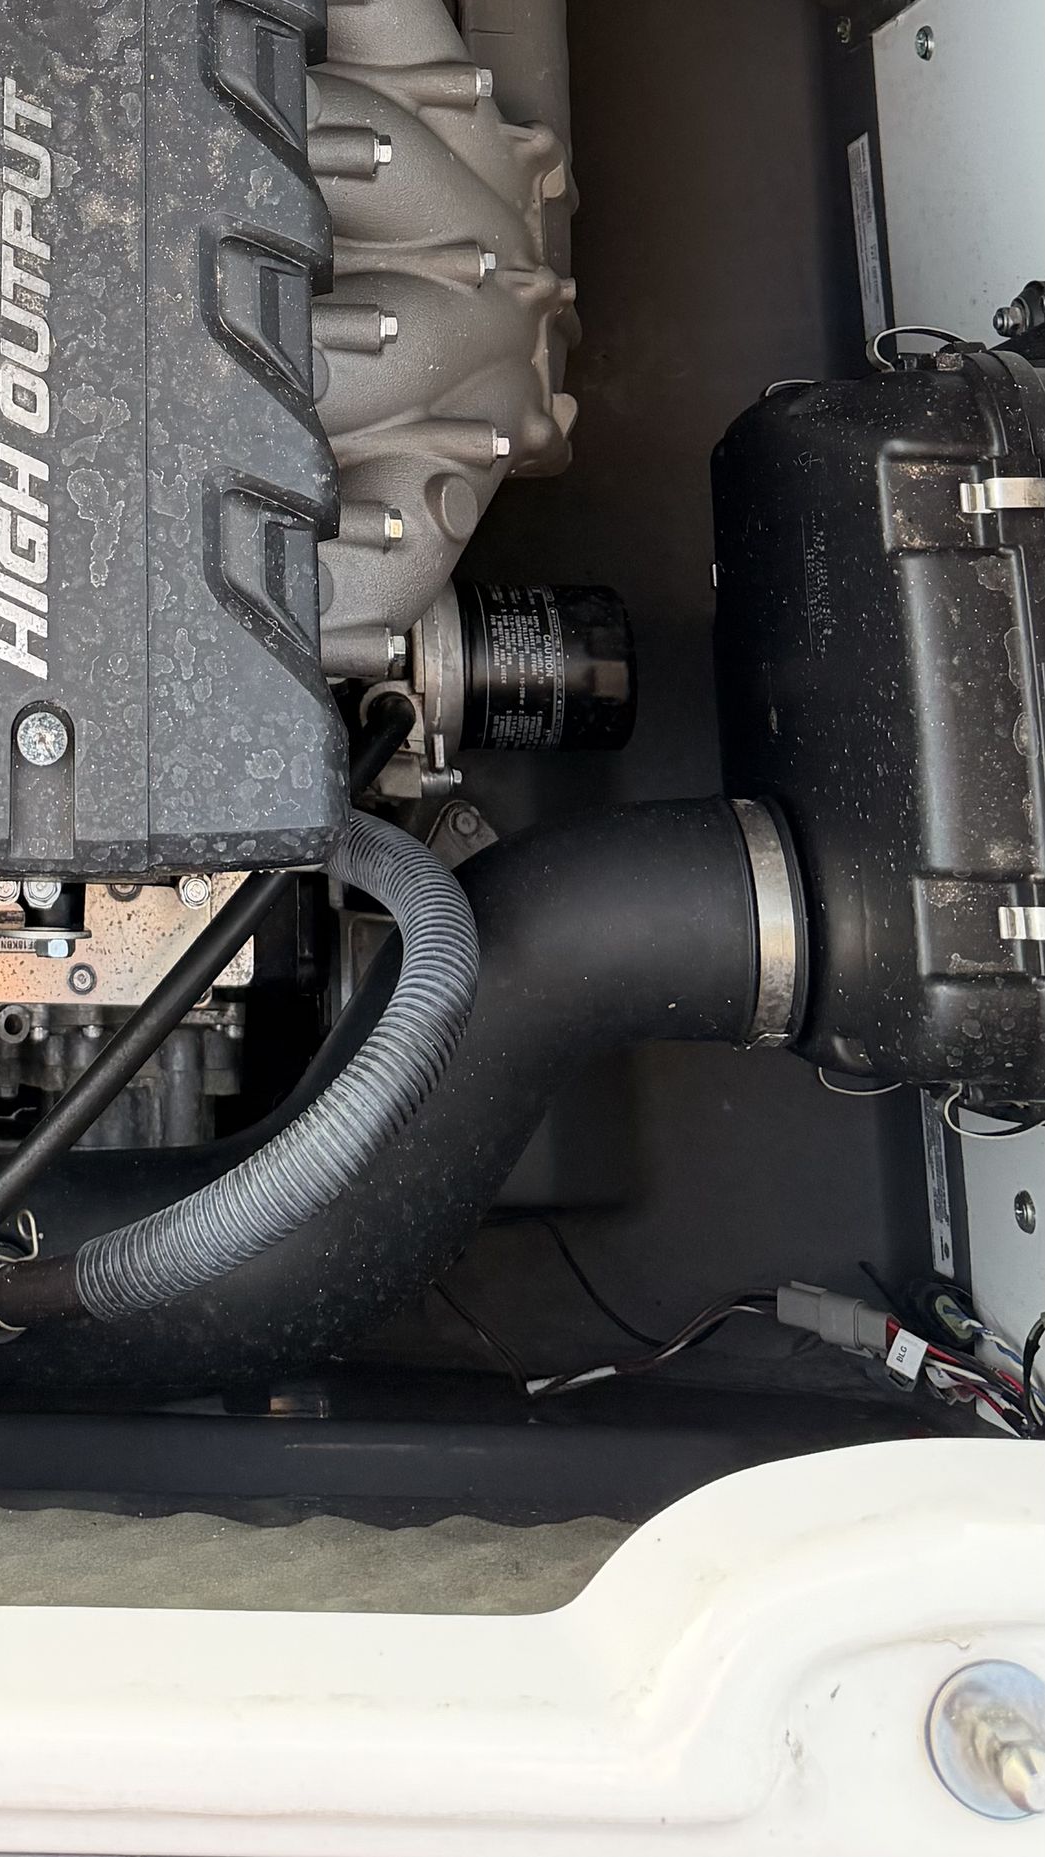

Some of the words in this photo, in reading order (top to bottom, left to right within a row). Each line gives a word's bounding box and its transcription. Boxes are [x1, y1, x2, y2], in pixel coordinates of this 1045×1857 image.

[0, 76, 52, 434] OUTPUT
[542, 633, 554, 677] CAUTION
[896, 1345, 908, 1363] BLG
